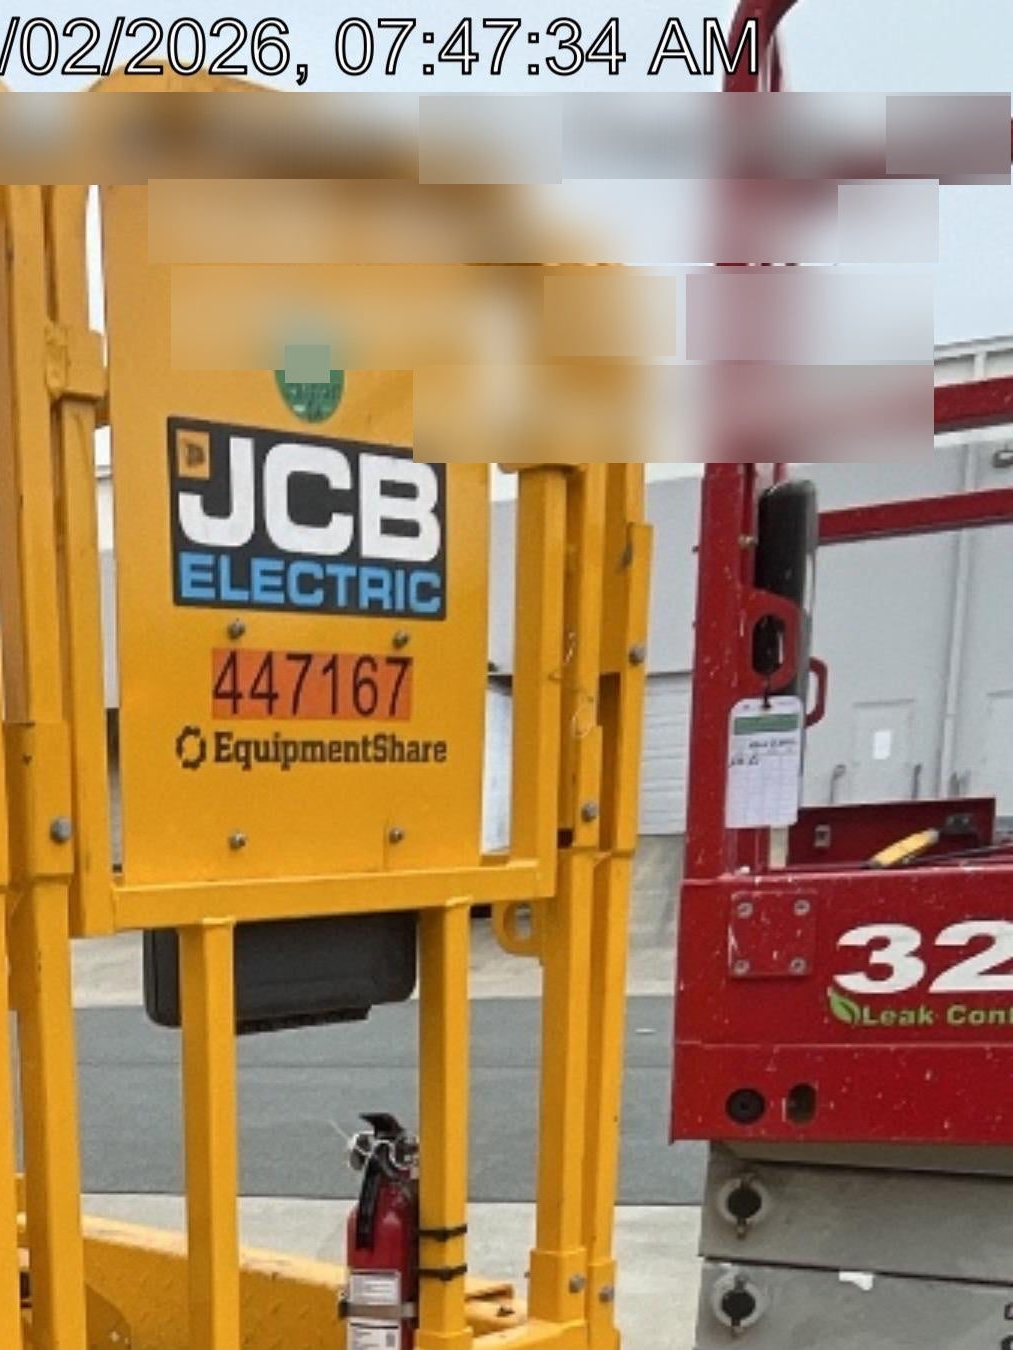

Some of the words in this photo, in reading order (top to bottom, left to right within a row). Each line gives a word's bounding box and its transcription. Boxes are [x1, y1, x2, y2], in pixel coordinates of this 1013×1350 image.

[178, 436, 441, 562] JCB
[178, 551, 441, 613] ELECTRIC
[213, 650, 413, 718] 447167
[214, 731, 448, 771] EquipmentShare
[862, 1003, 934, 1025] Leak
